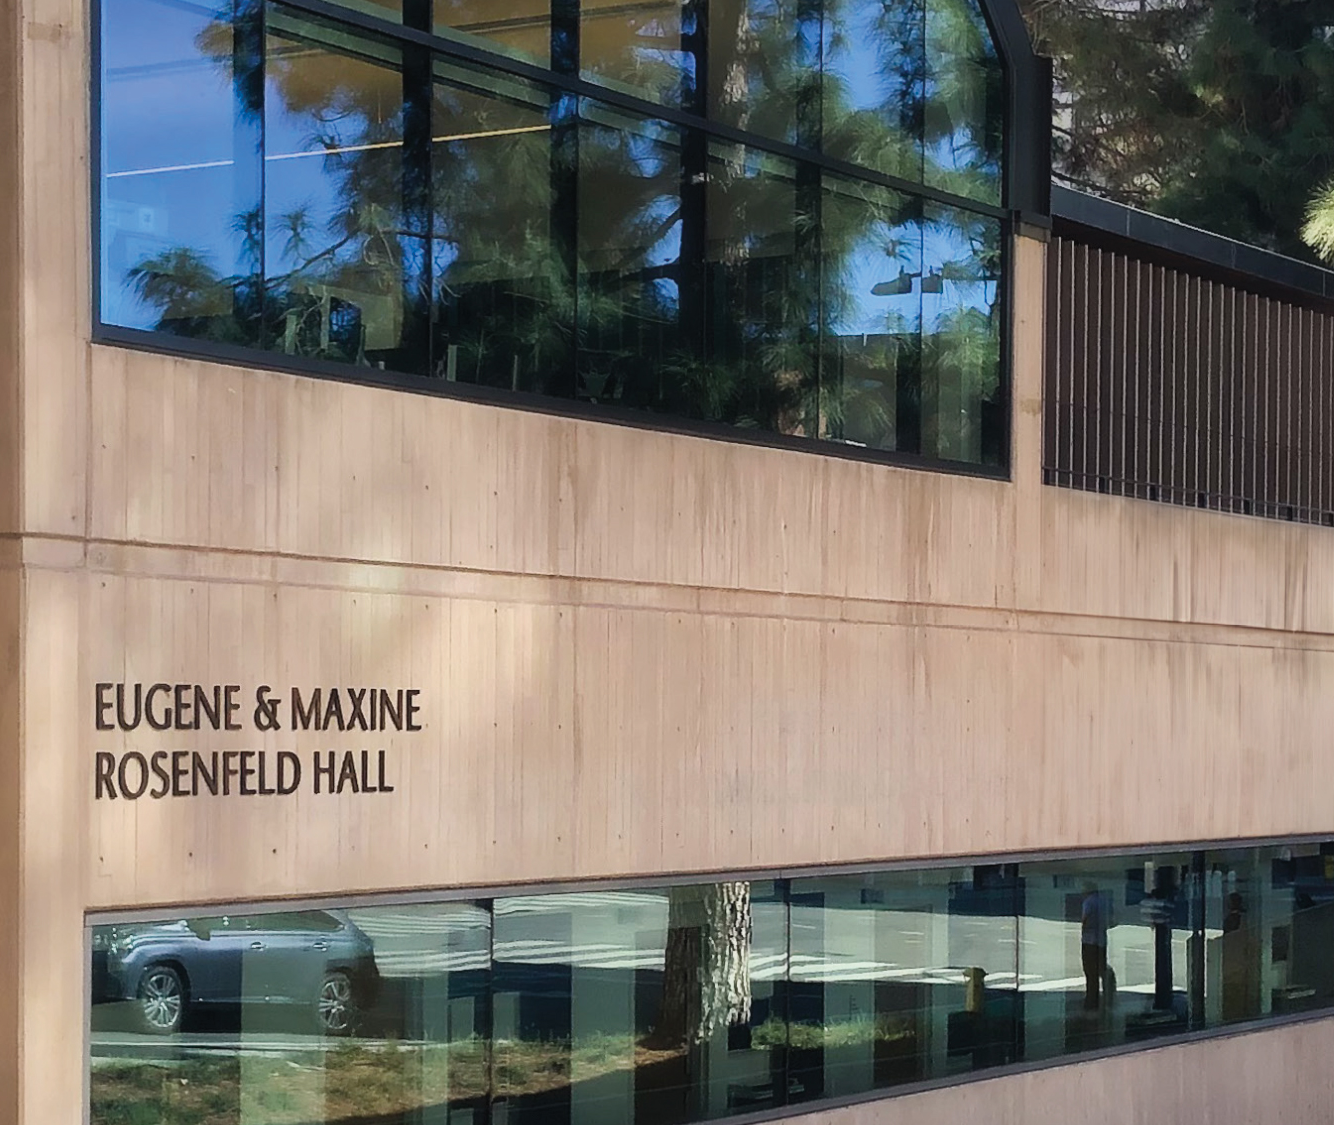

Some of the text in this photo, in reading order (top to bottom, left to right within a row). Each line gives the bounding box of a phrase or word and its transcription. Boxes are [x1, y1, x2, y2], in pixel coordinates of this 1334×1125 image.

[95, 682, 423, 732] EUGENE & MAXINE
[95, 750, 395, 801] ROSENFELD HALL
